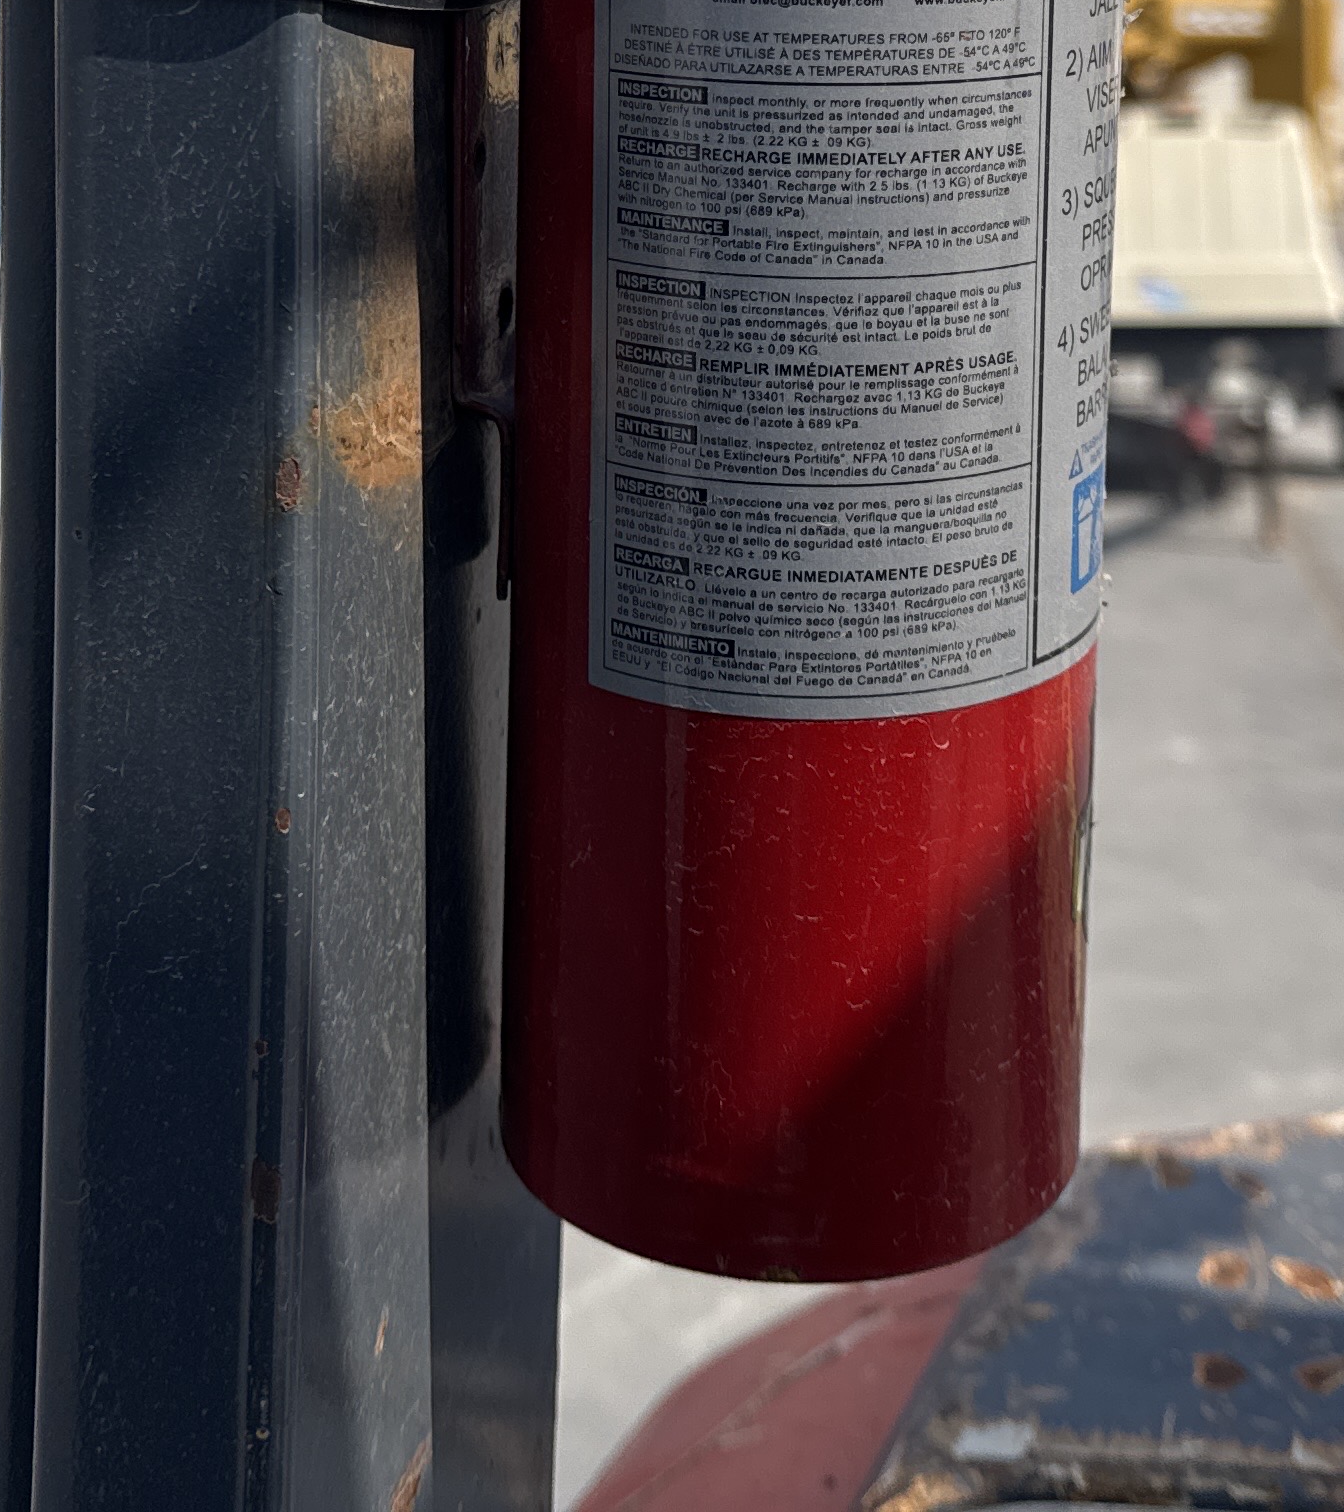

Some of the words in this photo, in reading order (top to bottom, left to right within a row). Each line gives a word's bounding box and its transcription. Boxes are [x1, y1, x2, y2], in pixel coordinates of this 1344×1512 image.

[630, 23, 689, 39] INTENDED
[692, 28, 719, 41] FOR
[722, 30, 750, 43] USE
[752, 31, 770, 43] AT
[772, 32, 885, 45] TEMPERATURES
[888, 32, 928, 44] FROM
[958, 30, 966, 42] F
[969, 29, 985, 41] TO
[1013, 25, 1021, 38] F
[792, 49, 821, 61] DES
[938, 46, 955, 59] DE
[991, 44, 1000, 55] A
[674, 58, 707, 72] PARA
[709, 61, 792, 76] UTILAZARSE
[795, 65, 805, 76] A
[809, 64, 918, 76] TEMPERATURAS
[922, 62, 964, 75] ENTRE
[1002, 58, 1011, 70] A
[1065, 46, 1083, 82] 2)
[620, 80, 702, 102] INSPECTION
[712, 93, 754, 106] Inspect
[829, 99, 861, 108] more
[865, 95, 924, 109] frequently
[927, 94, 958, 106] when
[714, 108, 735, 118] unit
[739, 108, 749, 119] is
[752, 110, 824, 121] pressurized
[828, 112, 843, 121] as
[902, 108, 925, 120] and
[998, 103, 1014, 113] the
[778, 123, 801, 134] and
[805, 123, 825, 134] the
[828, 125, 872, 136] tamper
[955, 119, 987, 131] Gross
[990, 114, 1022, 128] weight
[619, 138, 697, 158] RECHARGE
[701, 147, 791, 165] RECHARGE
[797, 151, 907, 166] IMMEDIATELY
[910, 148, 960, 164] AFTER
[964, 145, 994, 161] ANY
[683, 162, 744, 176] authorized
[747, 167, 791, 178] service
[795, 169, 851, 181] company
[854, 167, 872, 178] for
[875, 167, 927, 180] recharge
[931, 167, 941, 176] in
[944, 161, 1005, 175] accordance
[1007, 157, 1026, 169] with
[674, 185, 726, 200] Chemical
[757, 192, 803, 204] Service
[807, 193, 853, 205] Manual
[932, 190, 954, 202] and
[777, 179, 837, 194] Recharge
[840, 181, 865, 192] with
[700, 201, 721, 214] 100
[724, 205, 741, 216] psi
[1062, 186, 1078, 221] 3)
[621, 210, 723, 233] MAINTENANCE
[765, 240, 789, 251] Fire
[976, 232, 999, 245] USA
[618, 273, 700, 295] INSPECTION
[710, 287, 790, 303] INSPECTION
[915, 290, 956, 302] chaque
[959, 286, 984, 298] mois
[835, 321, 858, 332] que
[876, 319, 912, 331] boyau
[1057, 323, 1074, 357] 4)
[616, 343, 693, 368] RECHARGE
[699, 357, 769, 376] REMPLIR
[696, 373, 761, 388] distributeur
[818, 382, 846, 392] pour
[864, 377, 935, 391] remplissage
[616, 416, 691, 442] ENTRETIEN
[908, 450, 936, 461] dans
[786, 501, 809, 510] una
[838, 501, 858, 512] por
[616, 546, 683, 573] RECARGA
[693, 561, 782, 582] RECARGUE
[787, 565, 928, 583] INMEDIATAMENTE
[1001, 549, 1017, 565] DE
[711, 598, 754, 610] manual
[777, 604, 824, 613] servicio
[718, 612, 750, 623] polvo
[903, 608, 974, 622] instrucciones
[994, 594, 1028, 608] Manual
[612, 621, 729, 655] MANTENIMIENTO
